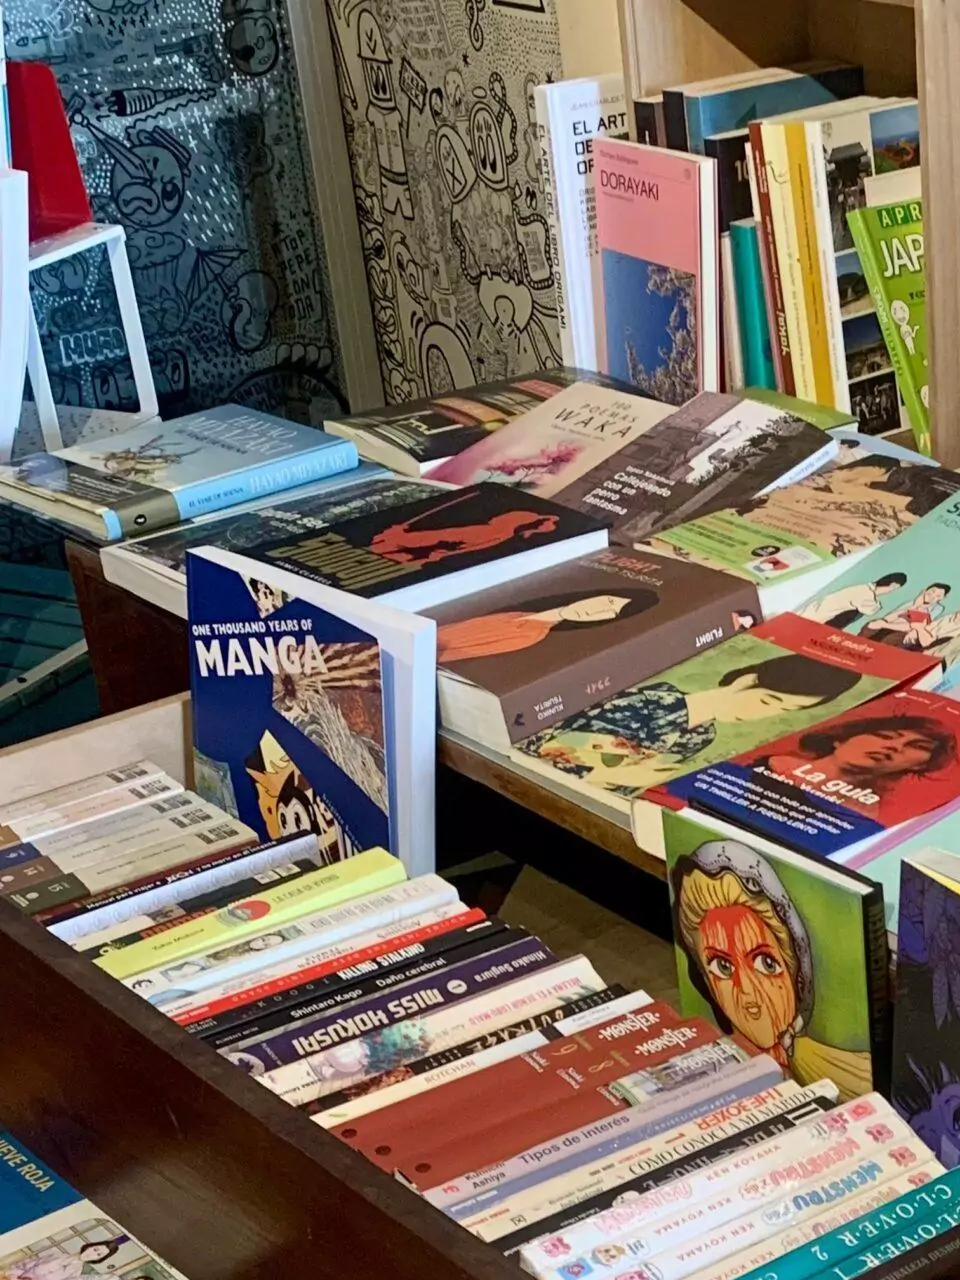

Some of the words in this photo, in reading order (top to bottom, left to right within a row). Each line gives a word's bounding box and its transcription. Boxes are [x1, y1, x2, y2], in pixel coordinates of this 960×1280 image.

[573, 120, 592, 136] EL
[601, 170, 659, 201] DORAYAKI
[555, 408, 633, 438] WAKA
[250, 467, 290, 494] HAYAO
[293, 452, 349, 481] MIYAZAKI
[192, 624, 211, 637] ONE
[211, 621, 266, 635] THOUSAND
[267, 619, 300, 633] YEARS
[300, 618, 313, 632] OF
[695, 626, 724, 648] FLIGHT
[194, 634, 328, 678] MANGA
[792, 763, 826, 783] La
[821, 779, 881, 806] gula
[336, 960, 379, 980] KILLING
[380, 943, 426, 967] STALKING
[375, 973, 405, 989] Daño
[404, 957, 447, 979] cerebral
[290, 998, 333, 1019] Shintaro
[333, 987, 363, 1005] Kago
[387, 988, 446, 1019] MISS
[291, 1010, 390, 1057] HOKUSAI
[600, 1011, 659, 1041] MONSTER
[636, 1027, 695, 1057] MONSTER
[519, 1143, 560, 1166] Tipos
[563, 1133, 581, 1147] de
[582, 1114, 630, 1139] interés
[23, 1162, 53, 1194] ROJA
